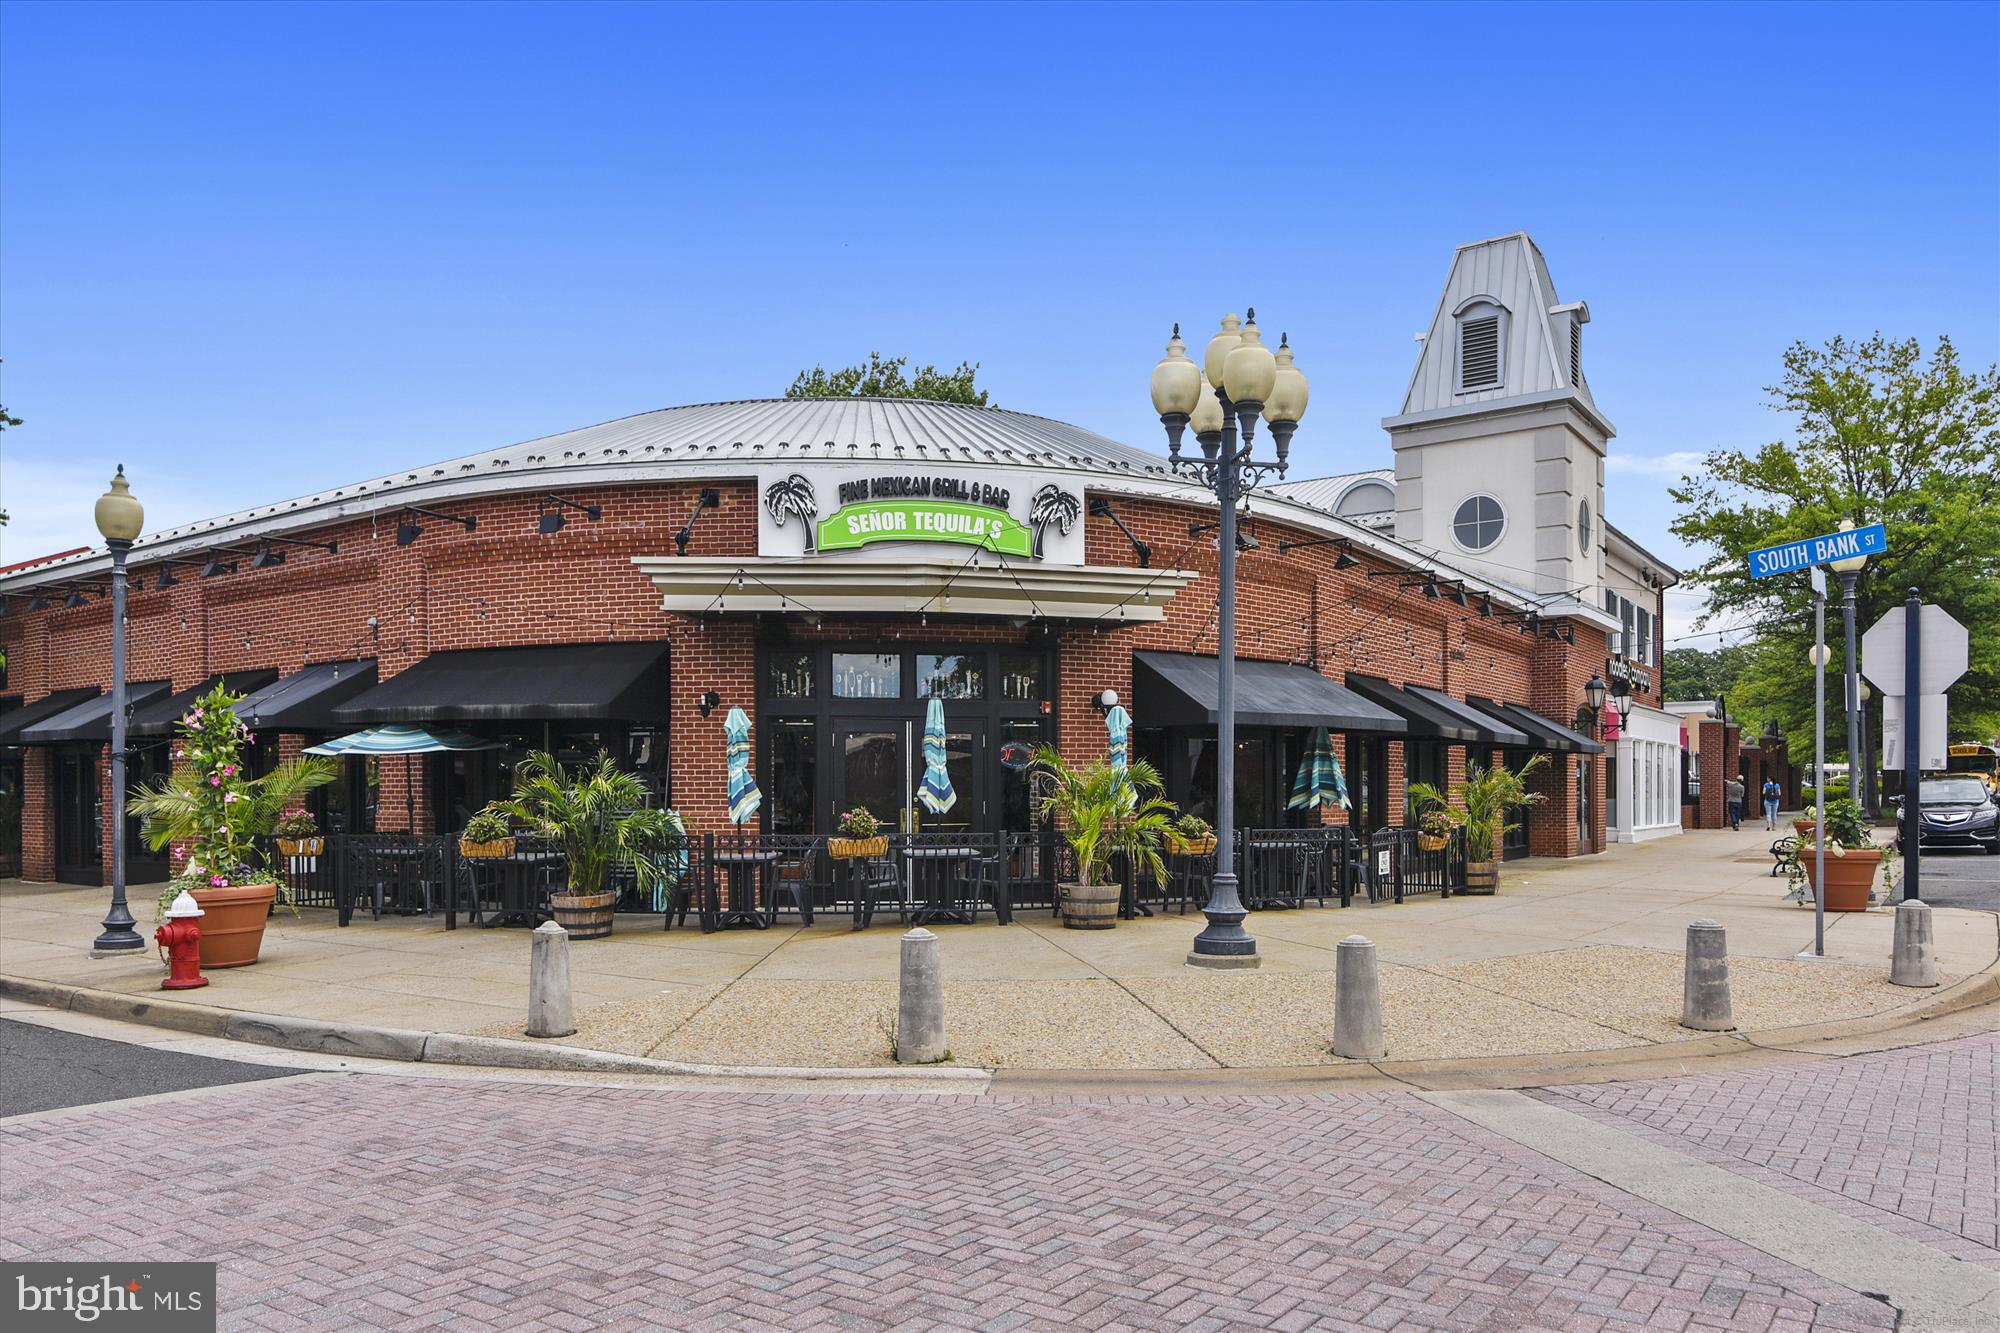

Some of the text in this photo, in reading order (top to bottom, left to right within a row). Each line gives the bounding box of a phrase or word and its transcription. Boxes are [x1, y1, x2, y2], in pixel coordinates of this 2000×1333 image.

[839, 476, 1010, 509] FINE MEXICAN GRILL & BAR
[847, 510, 1003, 539] SEÑOR TEQUILA'S
[1757, 533, 1875, 573] SOUTH BANK ST
[1609, 658, 1629, 679] noodles
